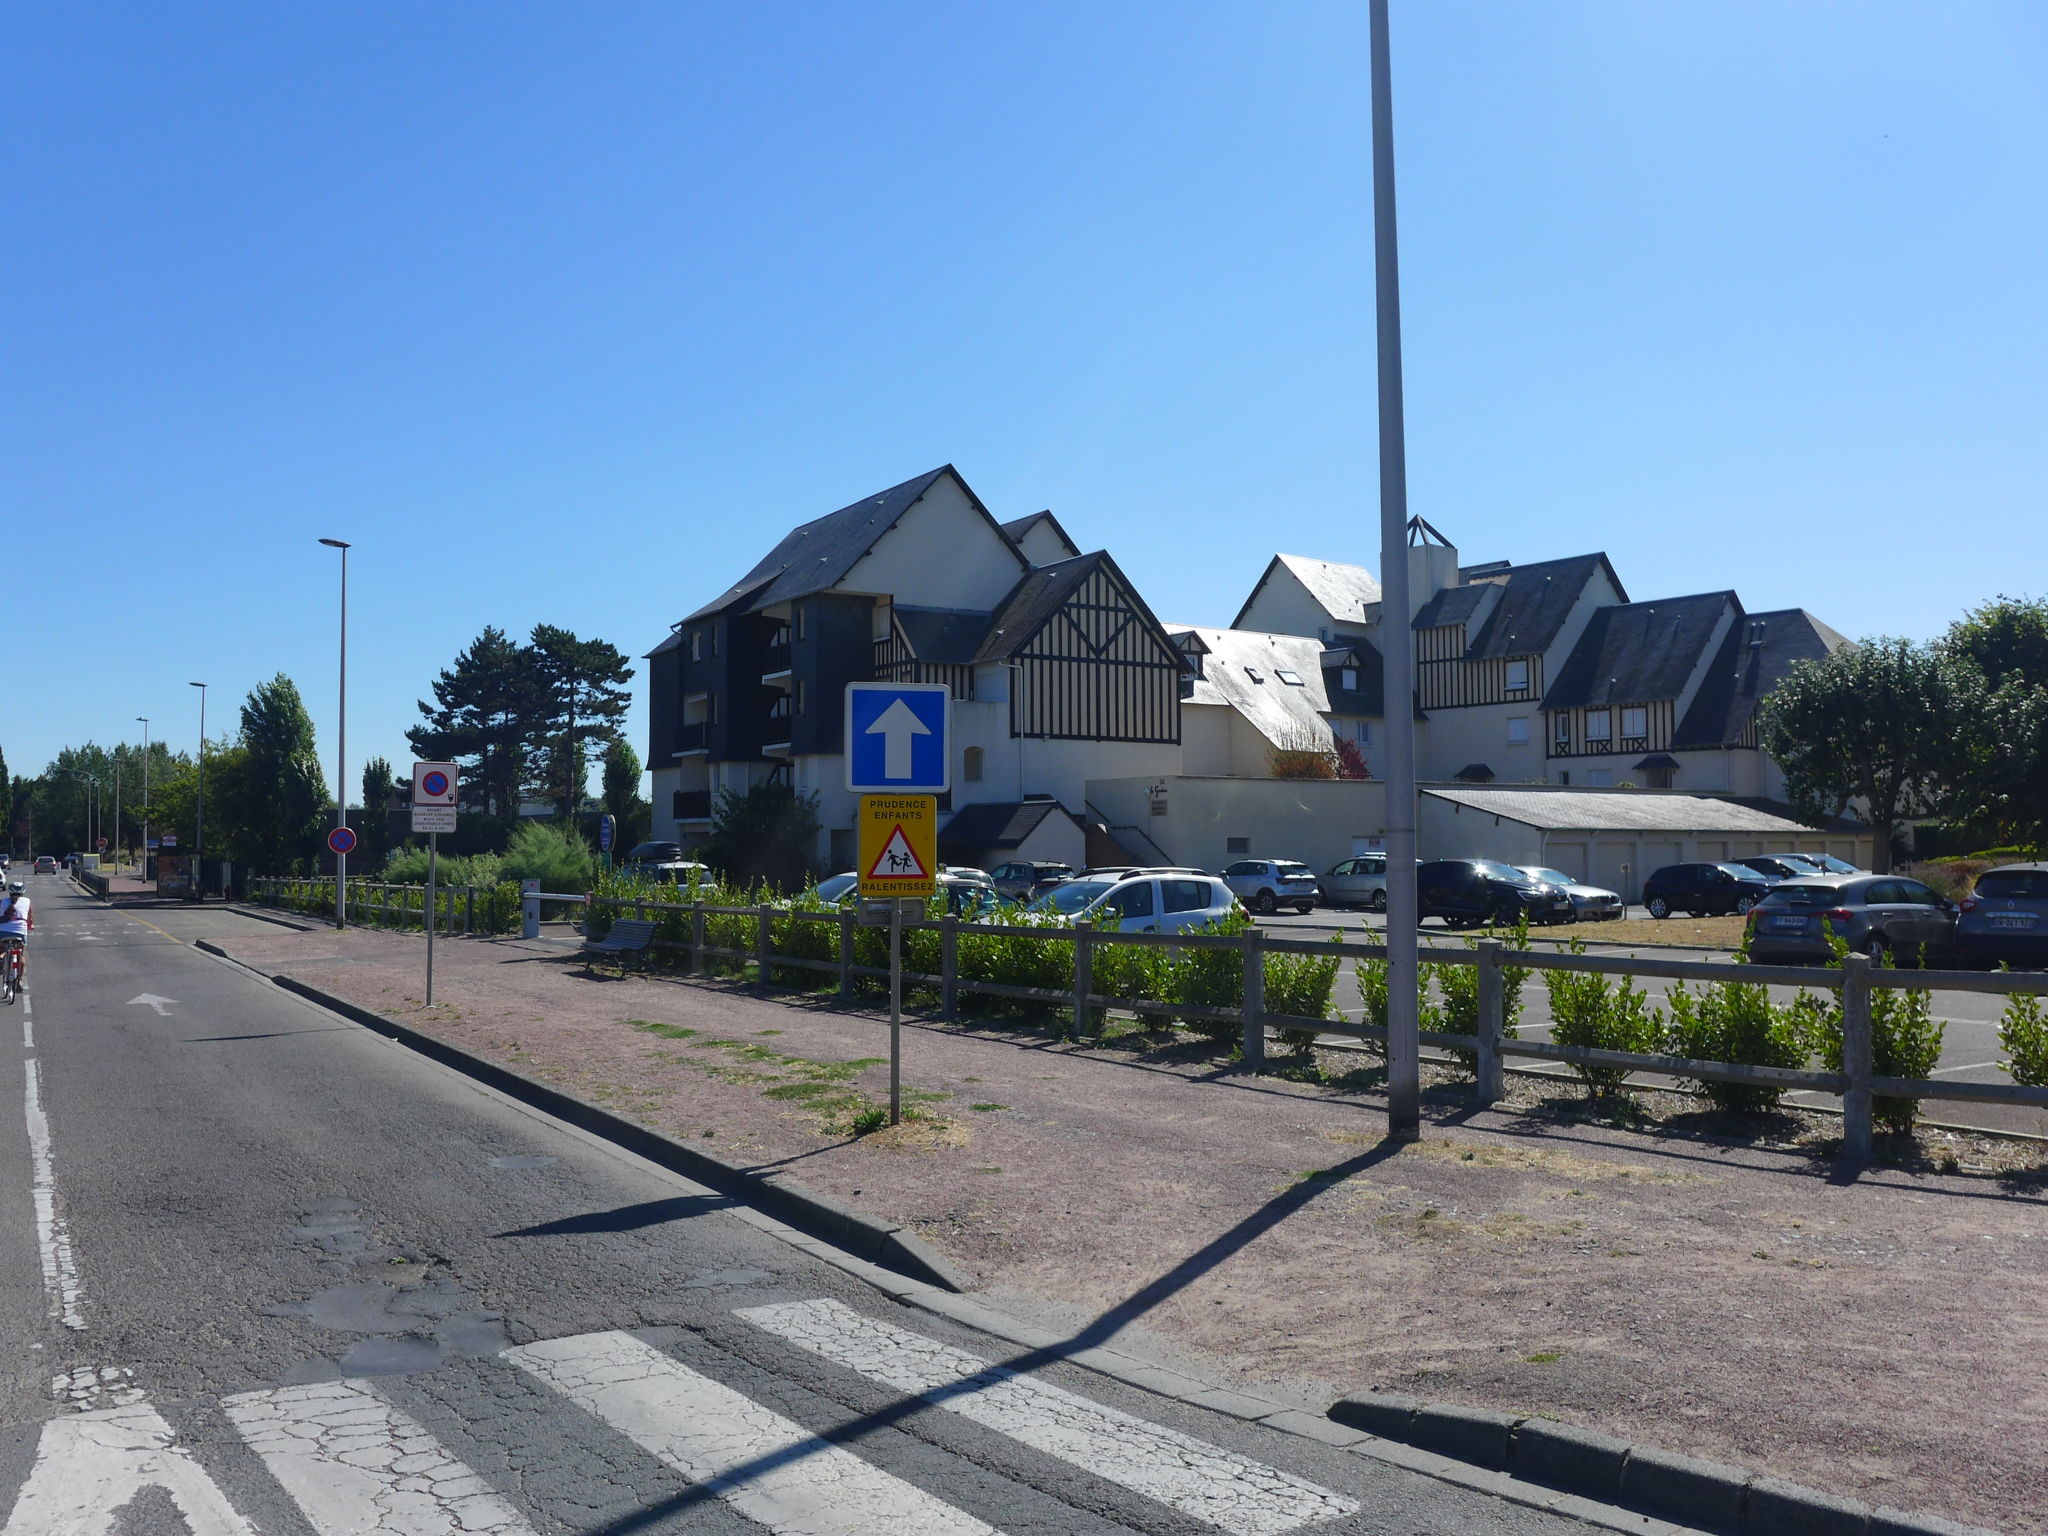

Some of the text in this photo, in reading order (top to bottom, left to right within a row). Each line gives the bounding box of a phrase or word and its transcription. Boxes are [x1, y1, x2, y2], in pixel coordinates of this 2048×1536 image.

[870, 800, 927, 809] PRUDENCE
[874, 811, 922, 820] ENFANTS
[861, 882, 934, 891] RALENTISSEZ
